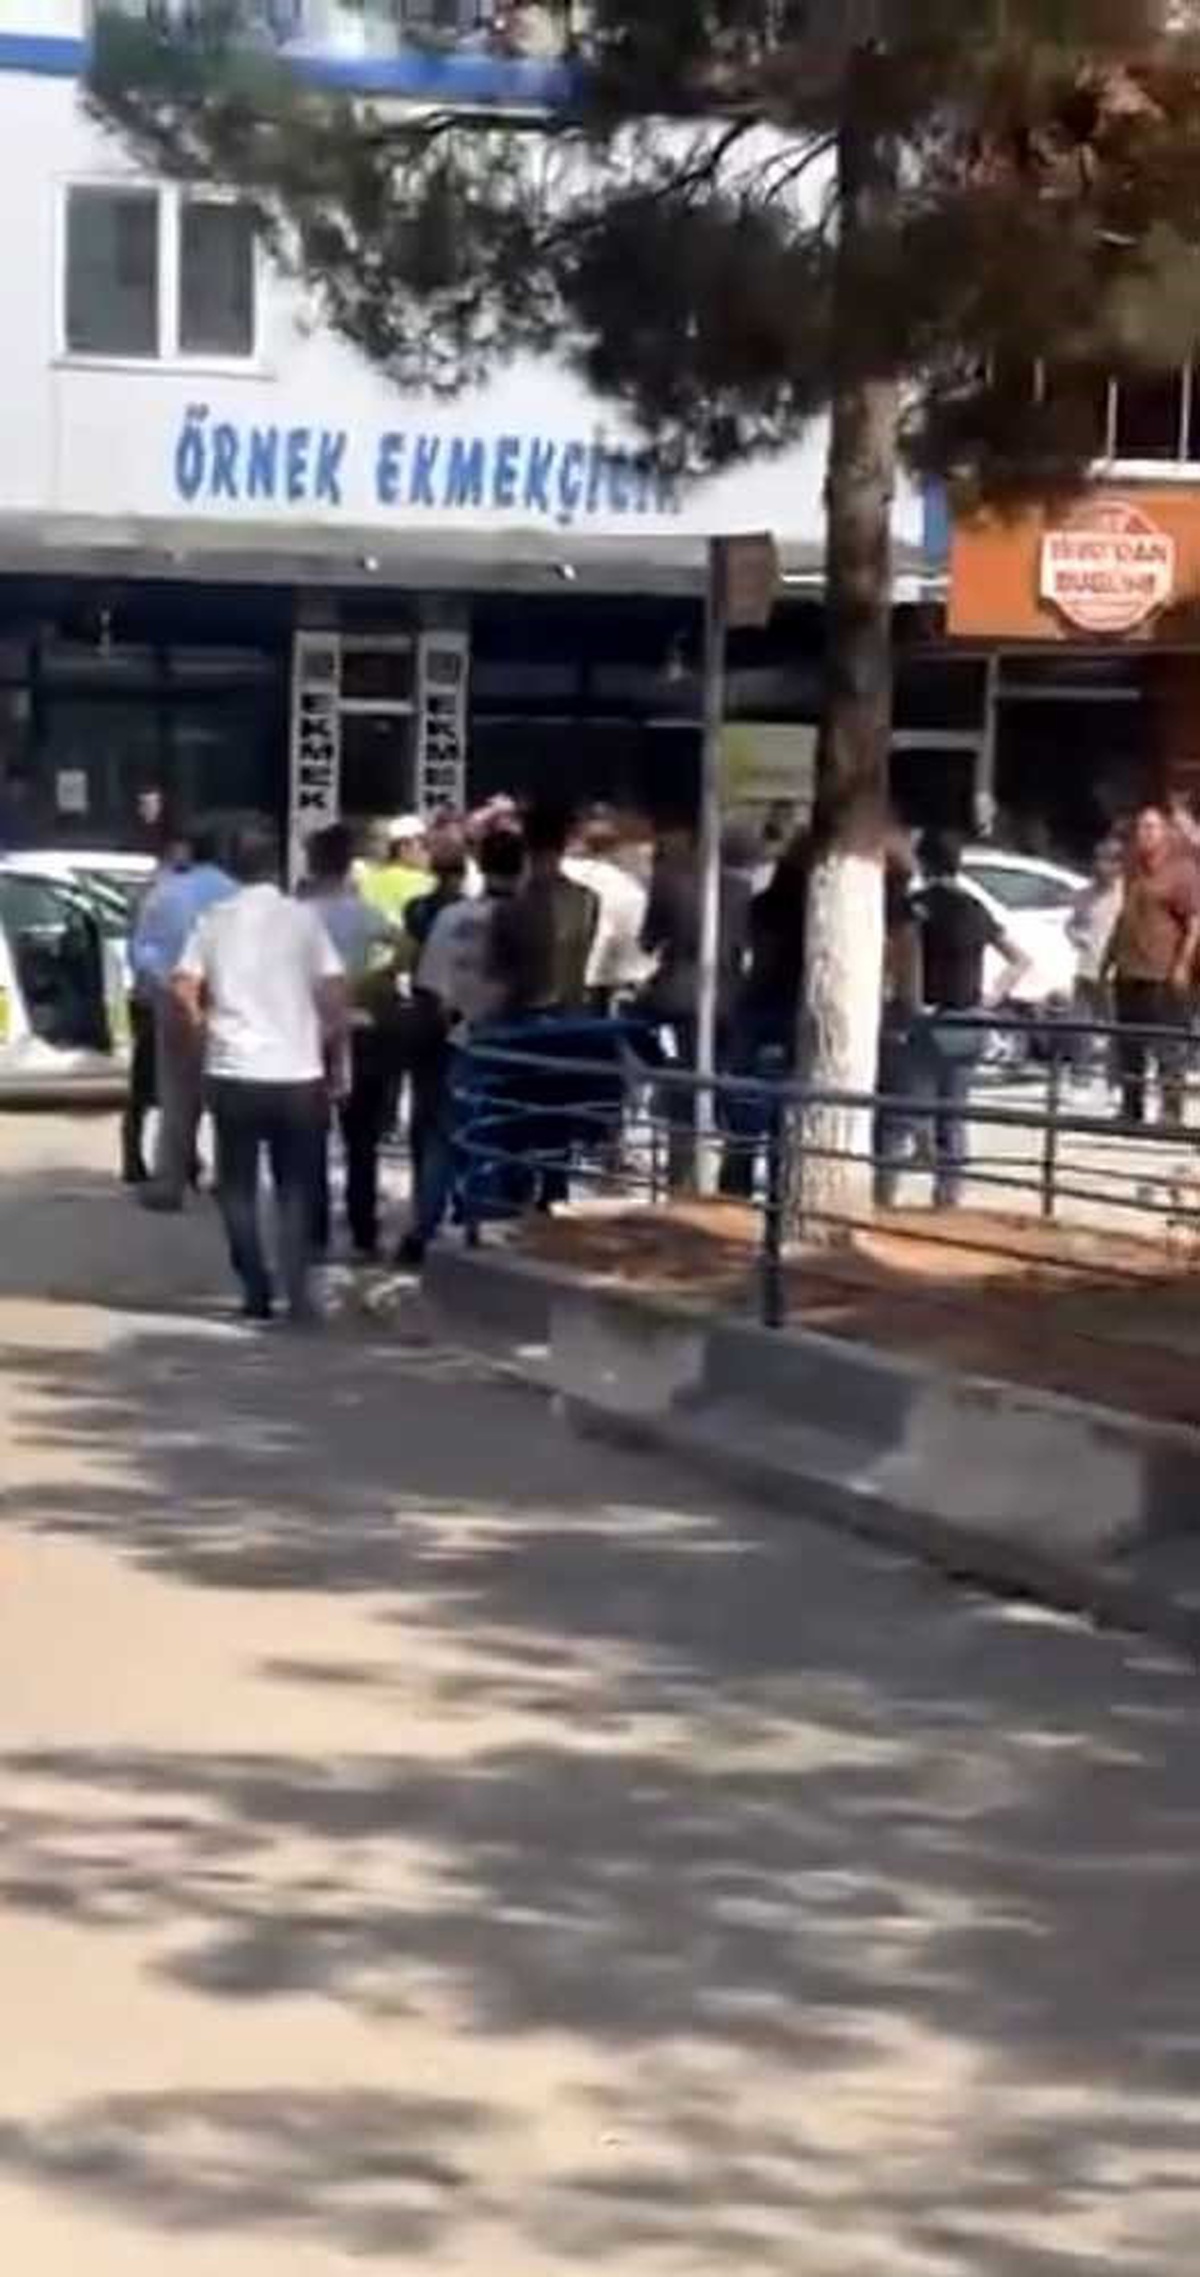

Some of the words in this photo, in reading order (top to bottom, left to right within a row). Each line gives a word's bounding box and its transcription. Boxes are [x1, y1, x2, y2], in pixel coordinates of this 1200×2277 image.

[174, 403, 346, 504] ÖRNEK
[301, 693, 333, 809] EKMEK
[426, 695, 458, 809] EKMEK
